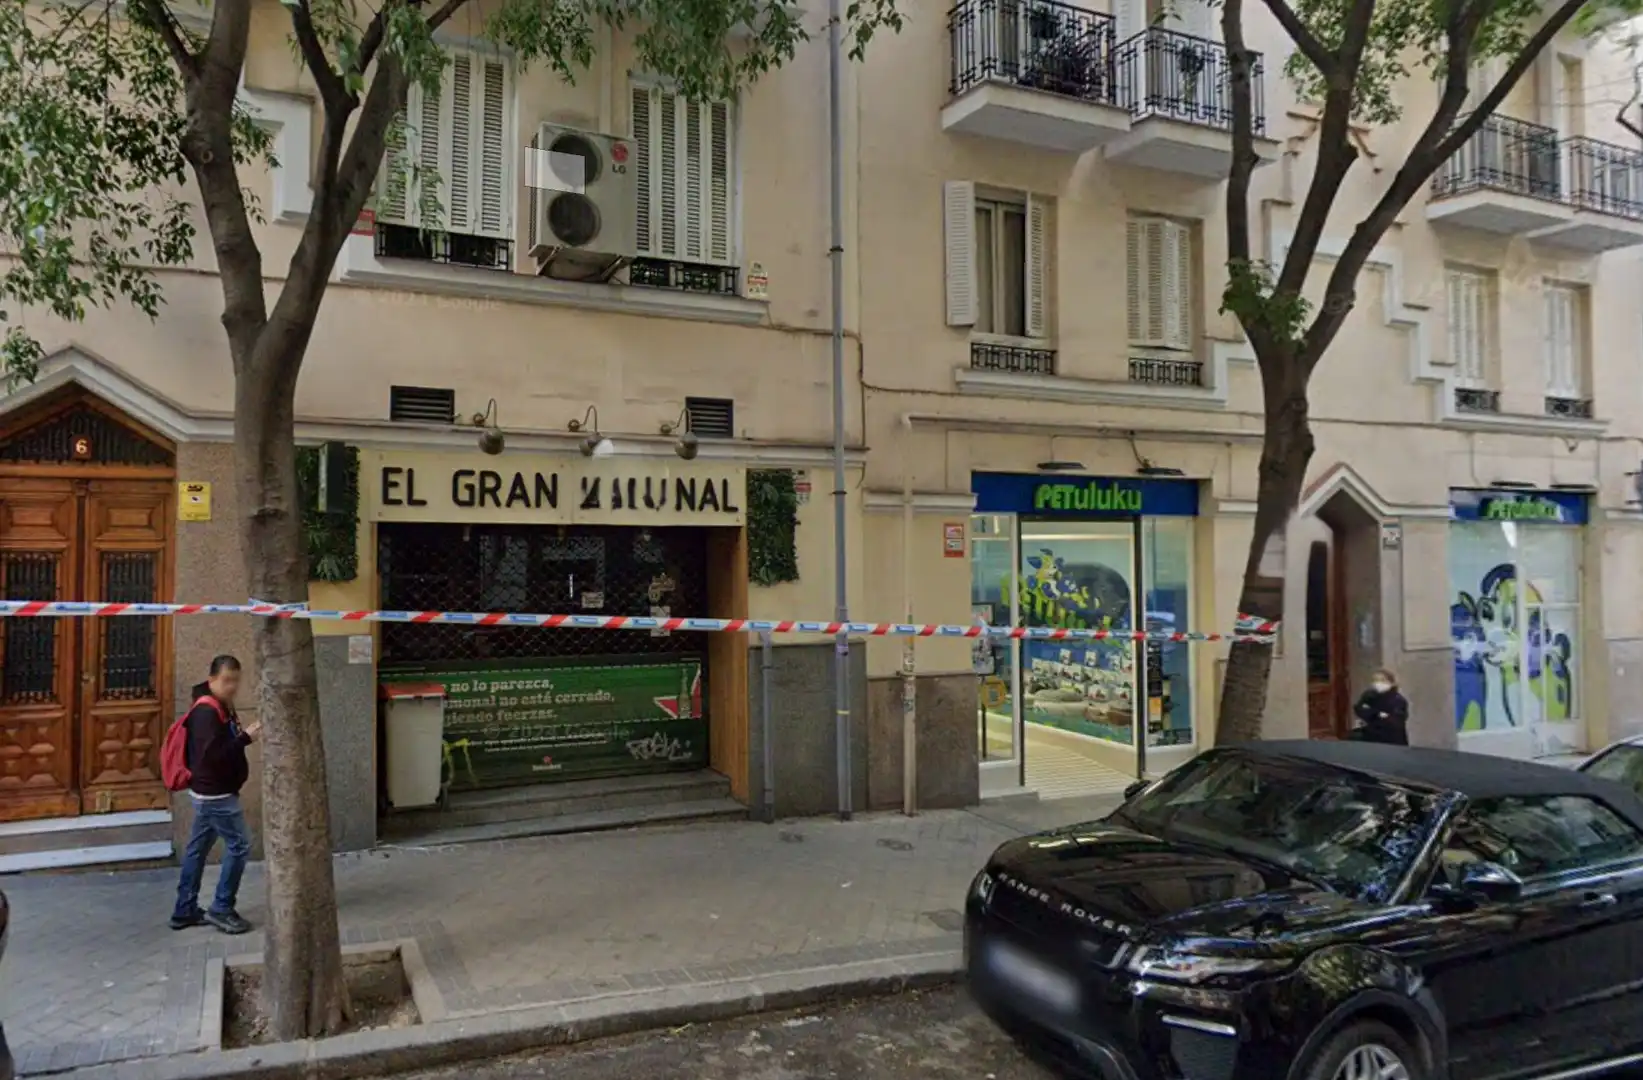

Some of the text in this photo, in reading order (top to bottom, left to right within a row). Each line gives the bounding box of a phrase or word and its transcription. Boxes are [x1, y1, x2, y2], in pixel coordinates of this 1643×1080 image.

[611, 163, 627, 175] LG
[75, 438, 88, 455] 6
[381, 466, 428, 507] EL
[451, 468, 559, 510] GRAN
[1034, 480, 1142, 511] PETuluku
[450, 679, 554, 694] no lo parezca,
[499, 696, 518, 706] no
[998, 872, 1132, 935] RANGE ROVER
